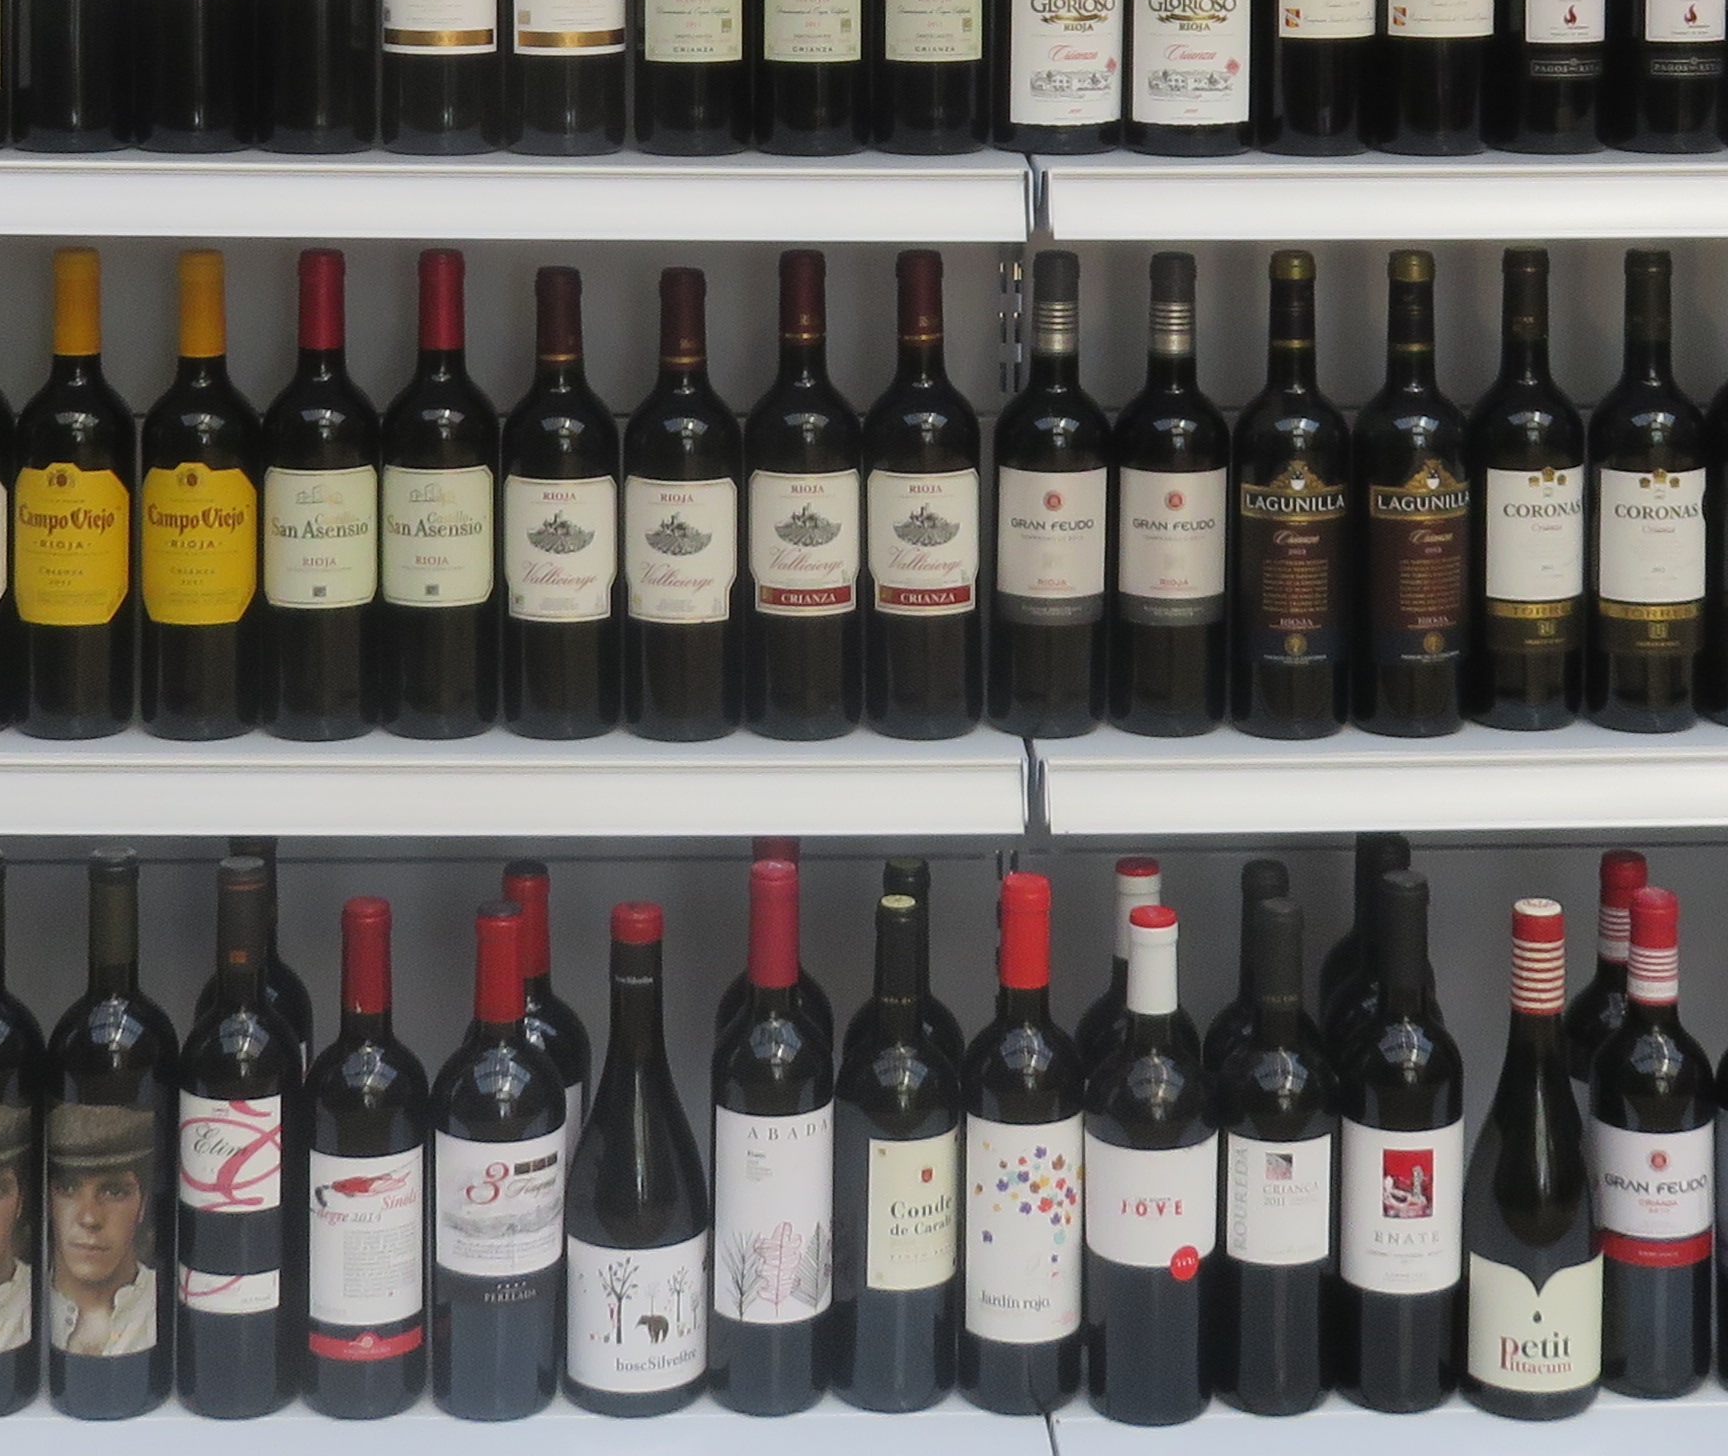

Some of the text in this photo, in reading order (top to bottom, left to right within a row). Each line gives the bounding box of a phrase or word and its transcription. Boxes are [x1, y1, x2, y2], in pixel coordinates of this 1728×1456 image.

[1246, 493, 1346, 514] LAGUNILLA
[1377, 492, 1470, 513] LAGUNILLA
[1502, 501, 1583, 520] CORONAS
[1614, 502, 1700, 520] CORONAS
[272, 517, 369, 539] San Asensio
[386, 515, 483, 538] San Asensio
[1010, 517, 1095, 532] GRAN FEUDO
[1132, 517, 1216, 532] GRAN FEUDO
[780, 591, 837, 605] CRIANZA
[900, 591, 957, 605] CRIANZA
[746, 1116, 830, 1142] ABADA
[466, 1161, 511, 1206] 3
[1604, 1171, 1710, 1196] GRAN FEUDO
[380, 1190, 419, 1211] Sinols
[889, 1193, 954, 1222] Conde
[1120, 1199, 1185, 1217] JOVE
[1372, 1229, 1441, 1246] ENATE
[1499, 1331, 1573, 1363] petit
[1499, 1346, 1572, 1375] Pittacum
